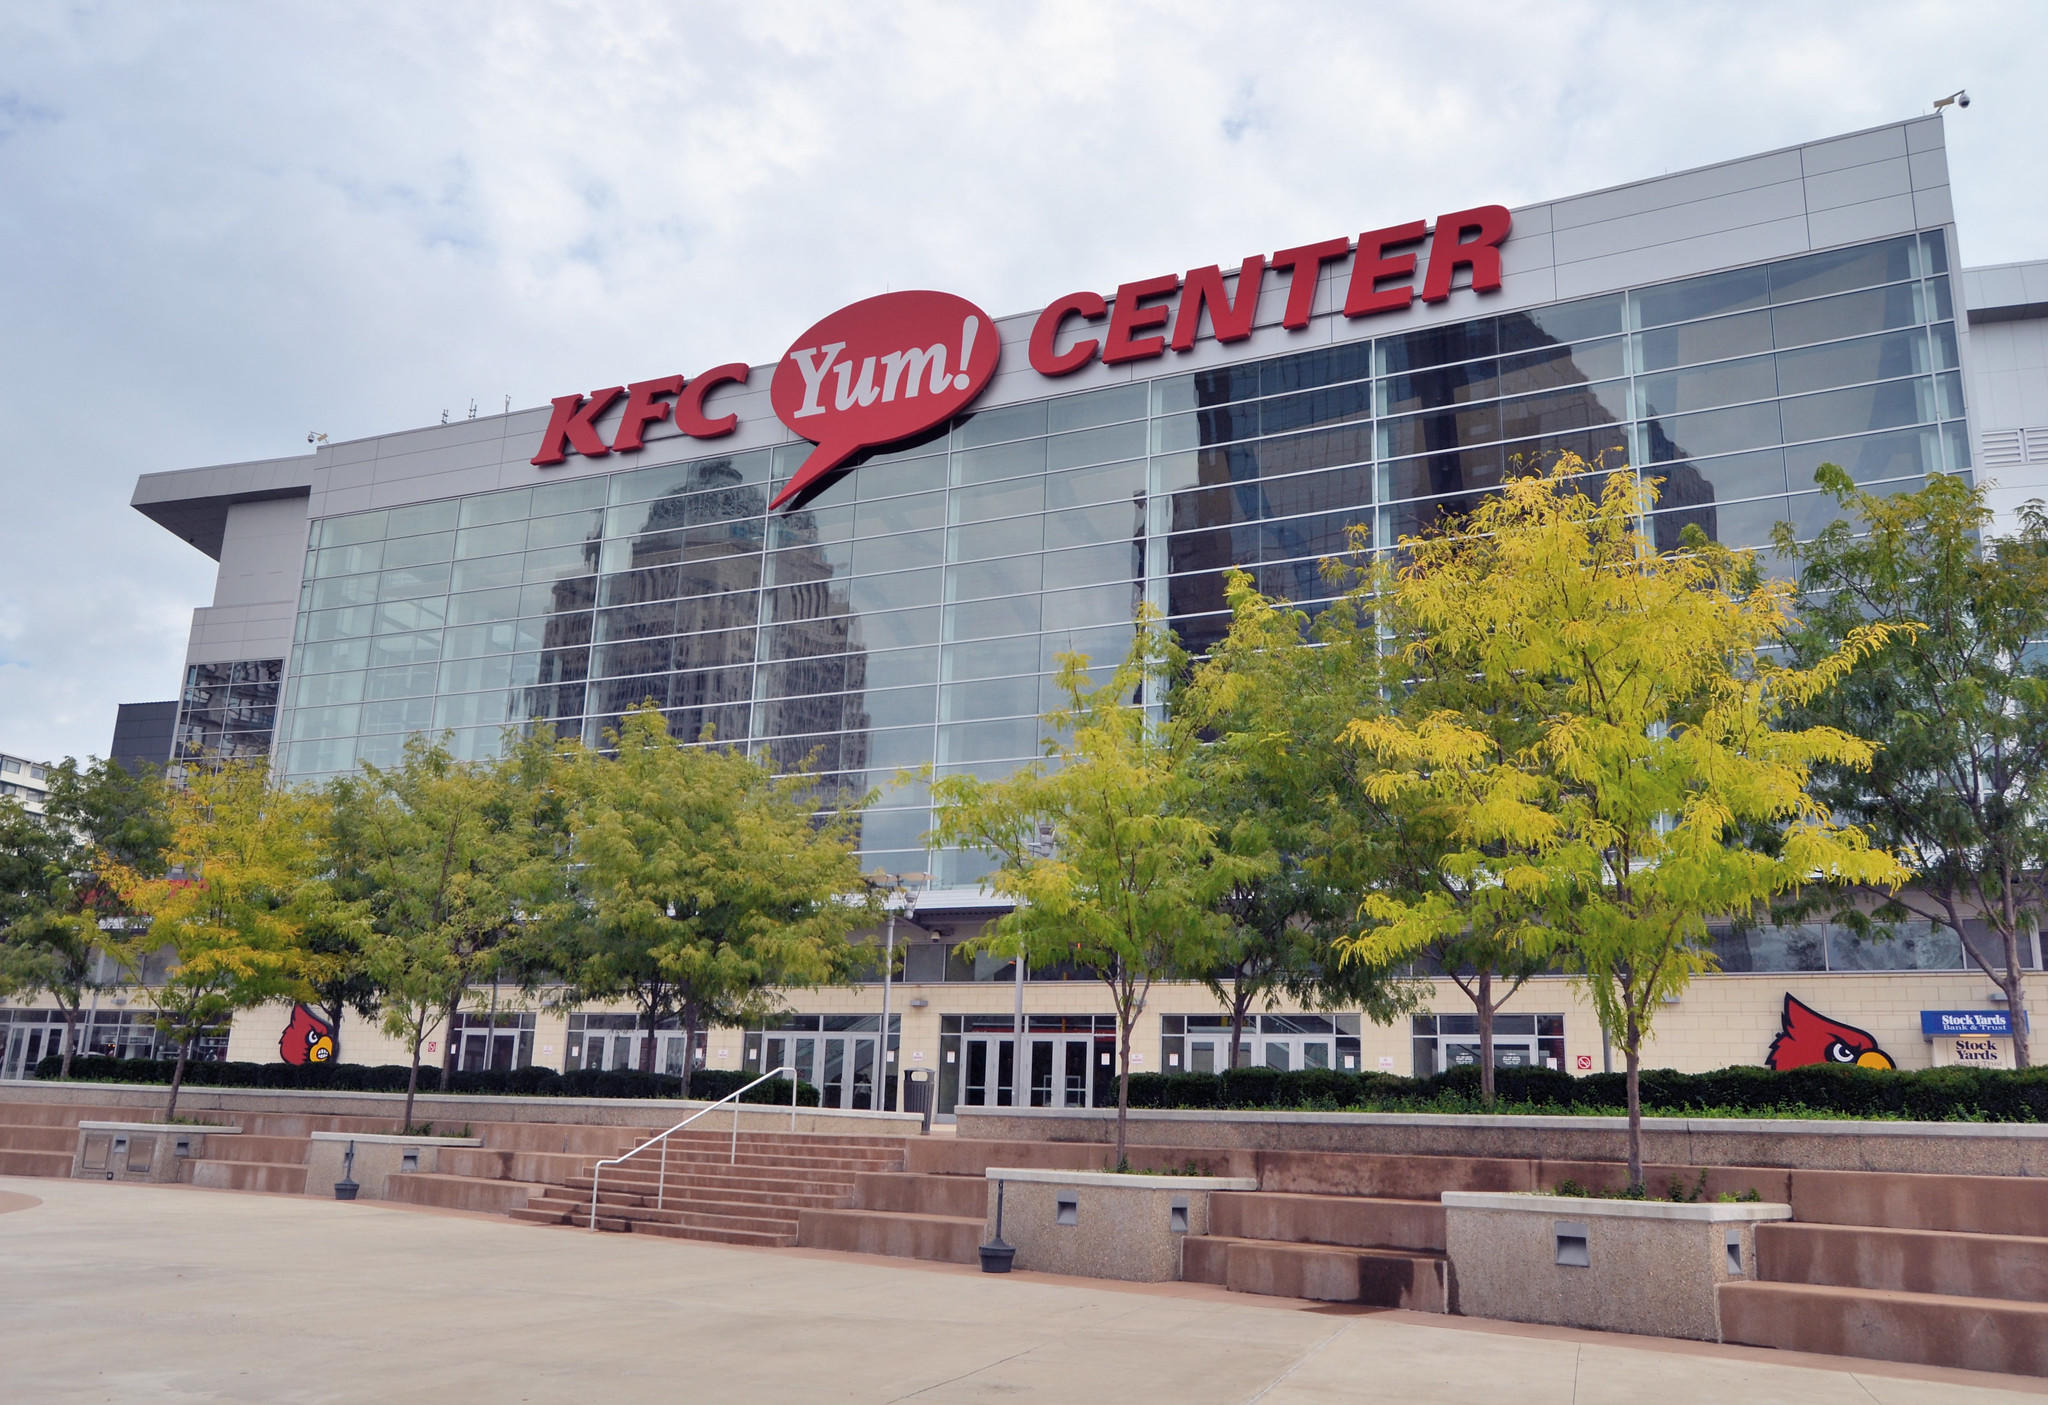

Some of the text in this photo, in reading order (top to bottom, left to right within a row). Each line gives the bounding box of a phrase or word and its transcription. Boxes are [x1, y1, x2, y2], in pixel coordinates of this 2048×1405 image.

[530, 205, 1511, 469] KFC Yum! CENTER
[1942, 1014, 2006, 1025] Stock Yards
[1956, 1040, 1997, 1050] Stock
[1957, 1050, 1998, 1060] Yards
